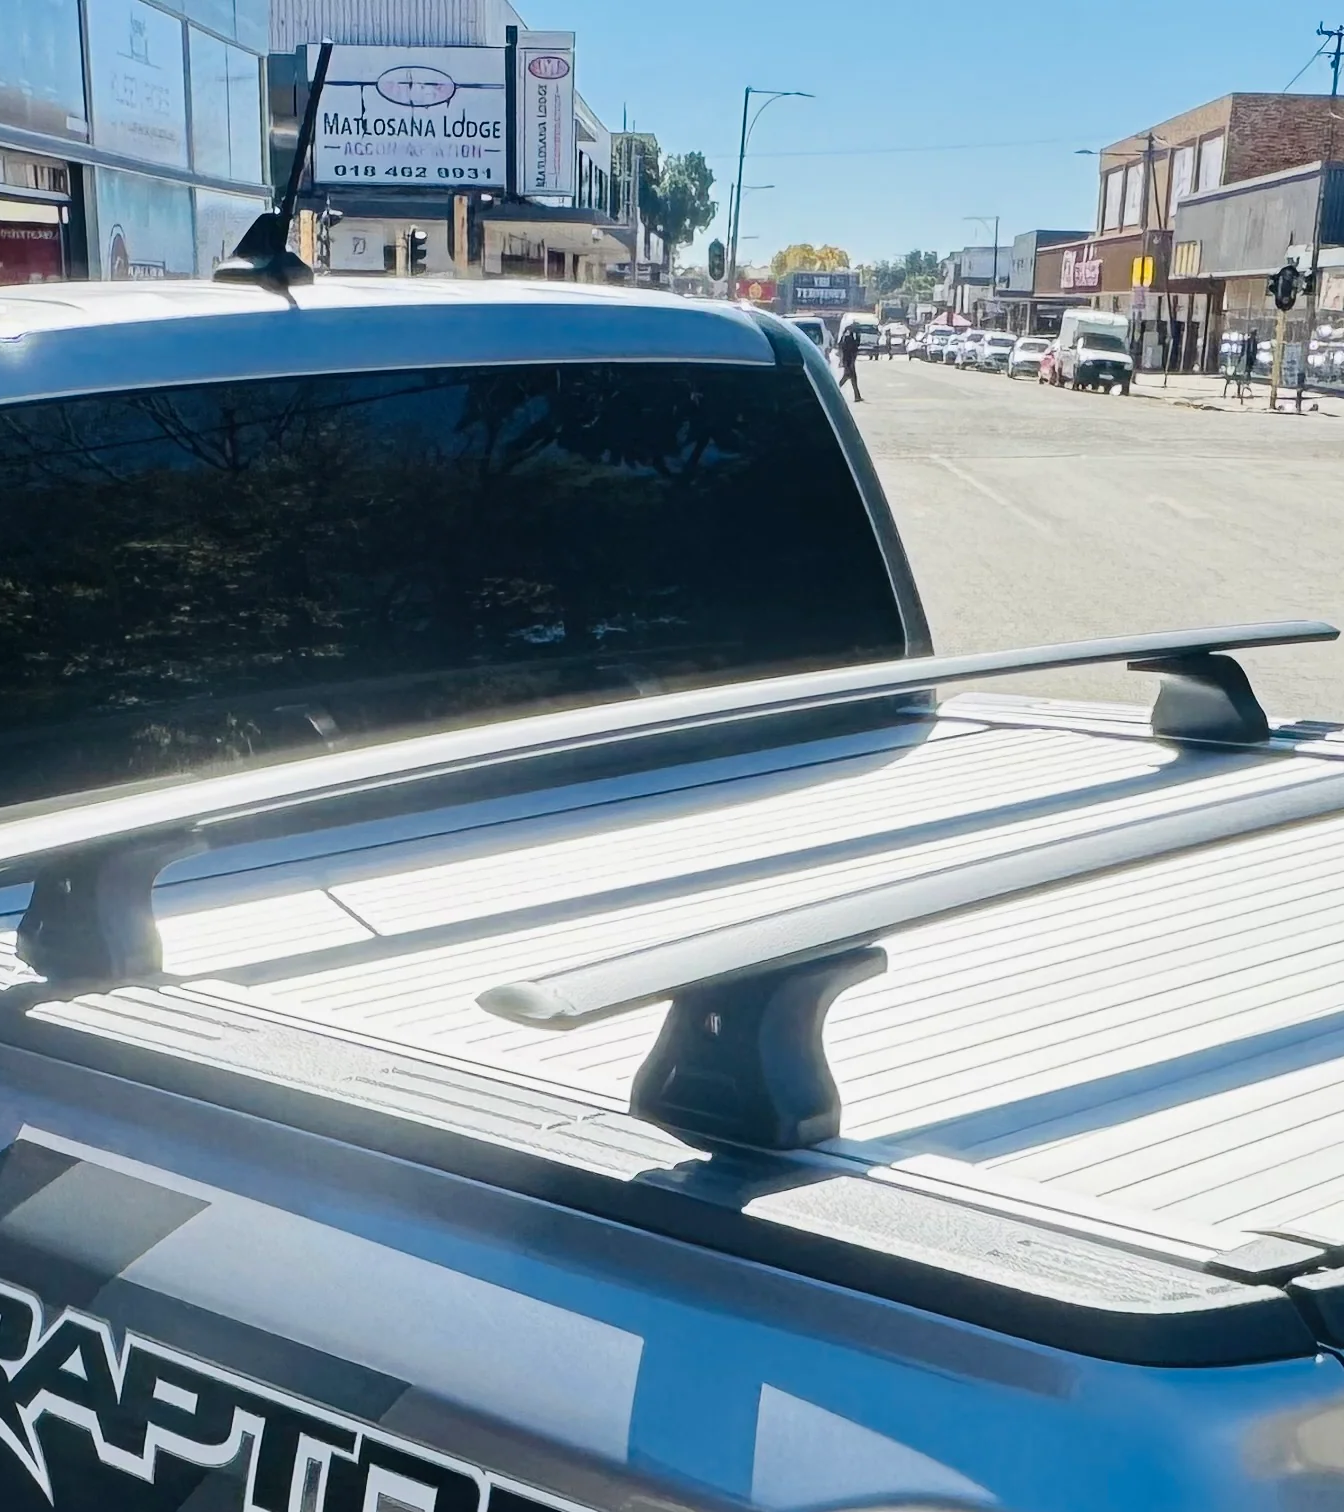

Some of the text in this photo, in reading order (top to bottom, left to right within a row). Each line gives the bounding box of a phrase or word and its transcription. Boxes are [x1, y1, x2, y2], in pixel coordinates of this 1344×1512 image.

[323, 112, 502, 139] MATLOSANA LODGE
[334, 164, 376, 177] 018
